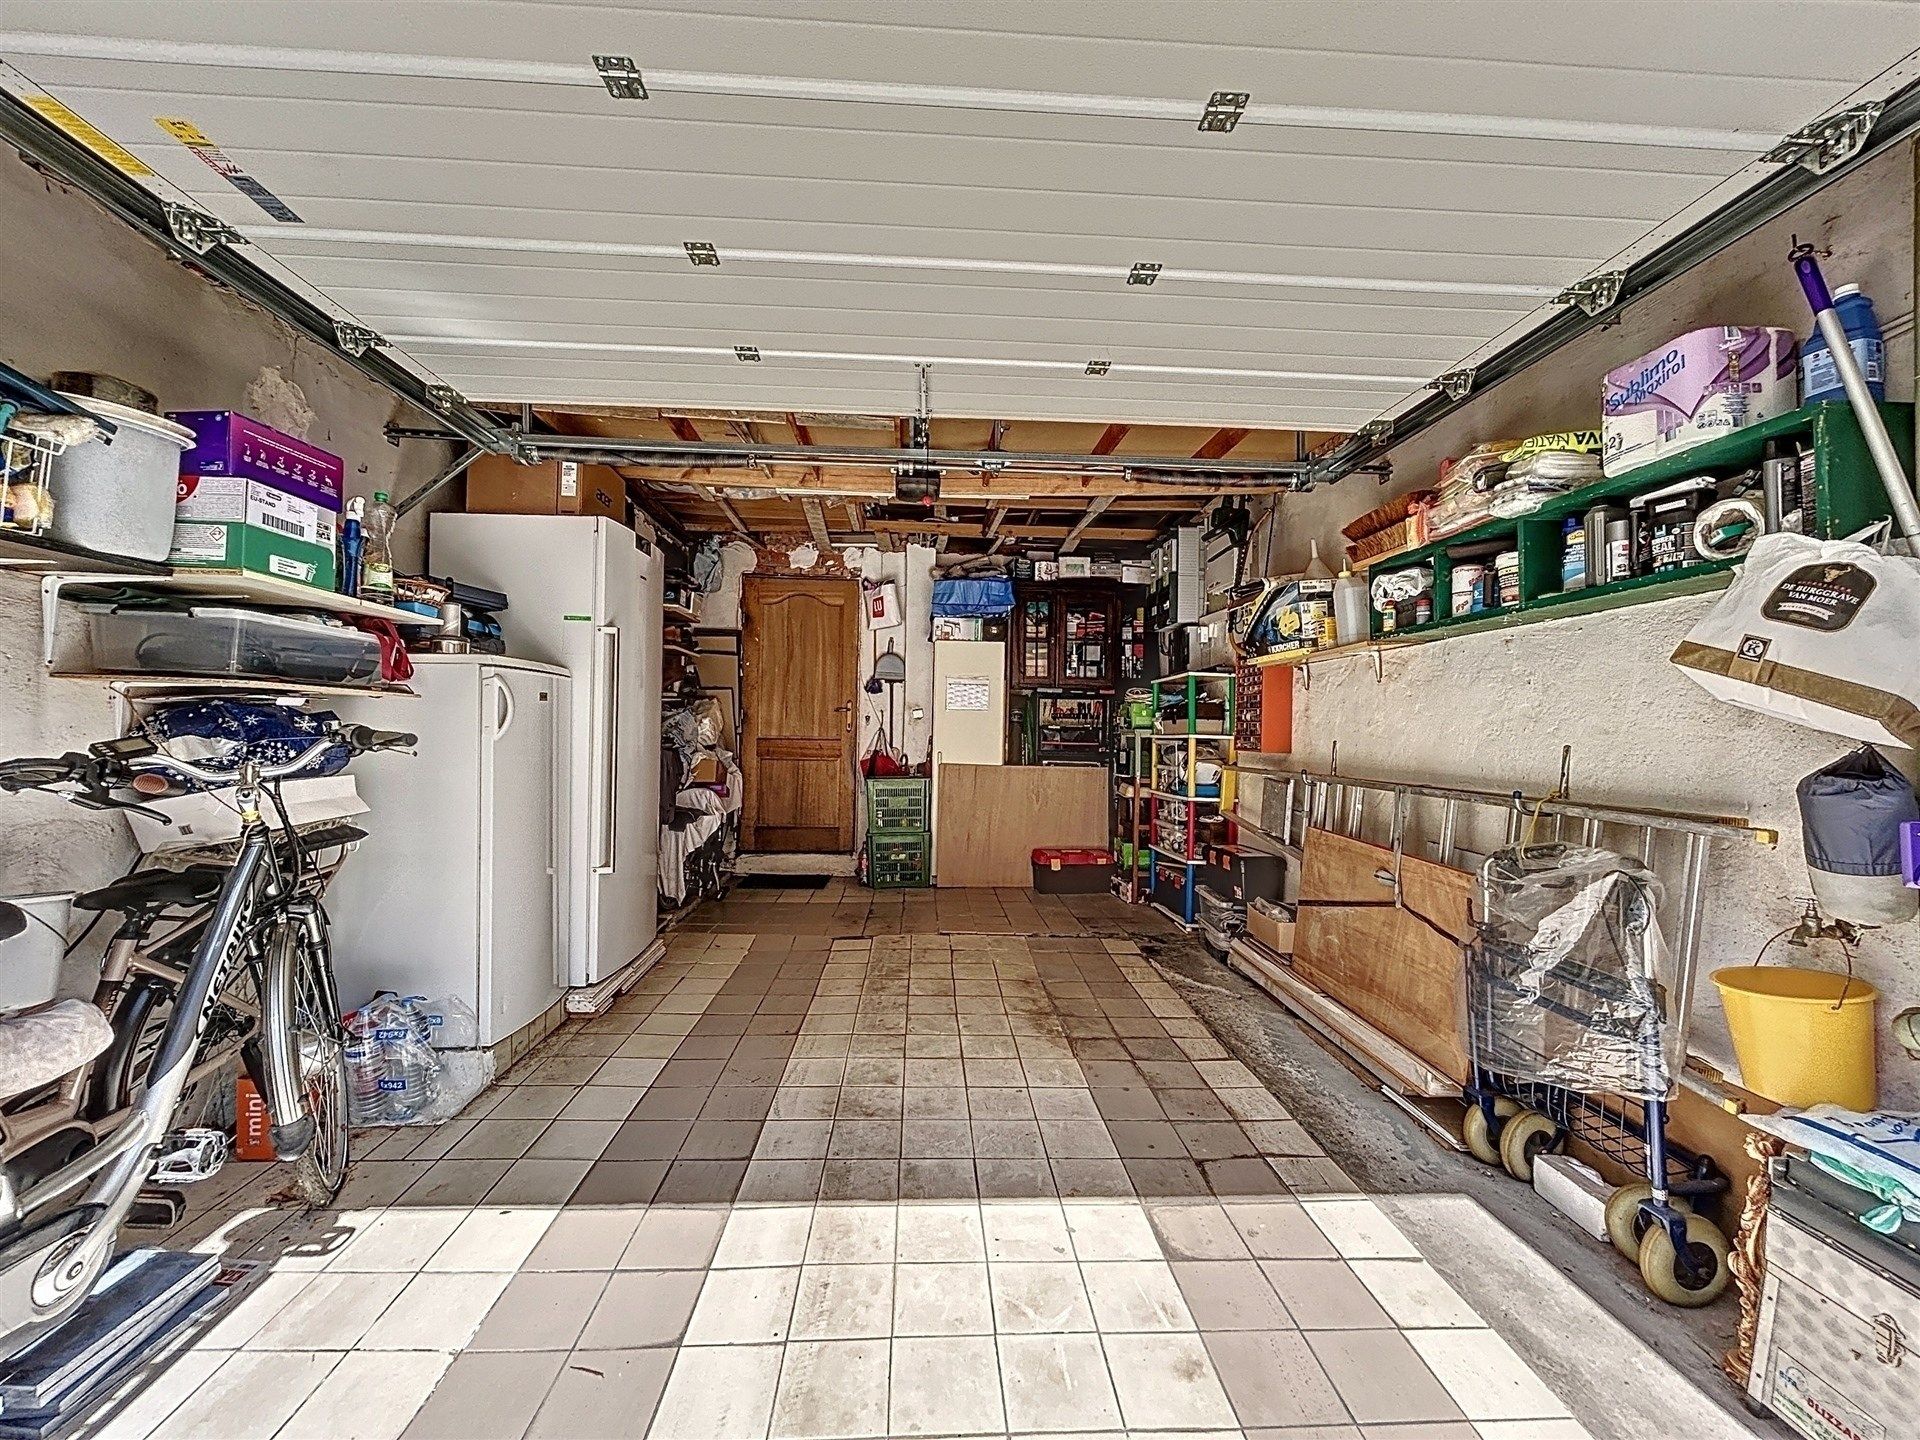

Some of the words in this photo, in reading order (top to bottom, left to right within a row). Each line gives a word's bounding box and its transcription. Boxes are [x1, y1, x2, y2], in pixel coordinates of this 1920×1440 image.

[1608, 349, 1679, 410] Sublimo
[1634, 354, 1686, 405] Maxirol
[249, 495, 276, 508] EU-STAND
[595, 488, 613, 509] acer
[1651, 541, 1676, 555] SEAL
[1781, 582, 1796, 592] DE
[1795, 585, 1860, 605] BURGGRAVE
[1788, 590, 1807, 601] VAN
[1807, 595, 1839, 607] MOER
[873, 599, 883, 612] LU
[245, 1093, 262, 1136] mini
